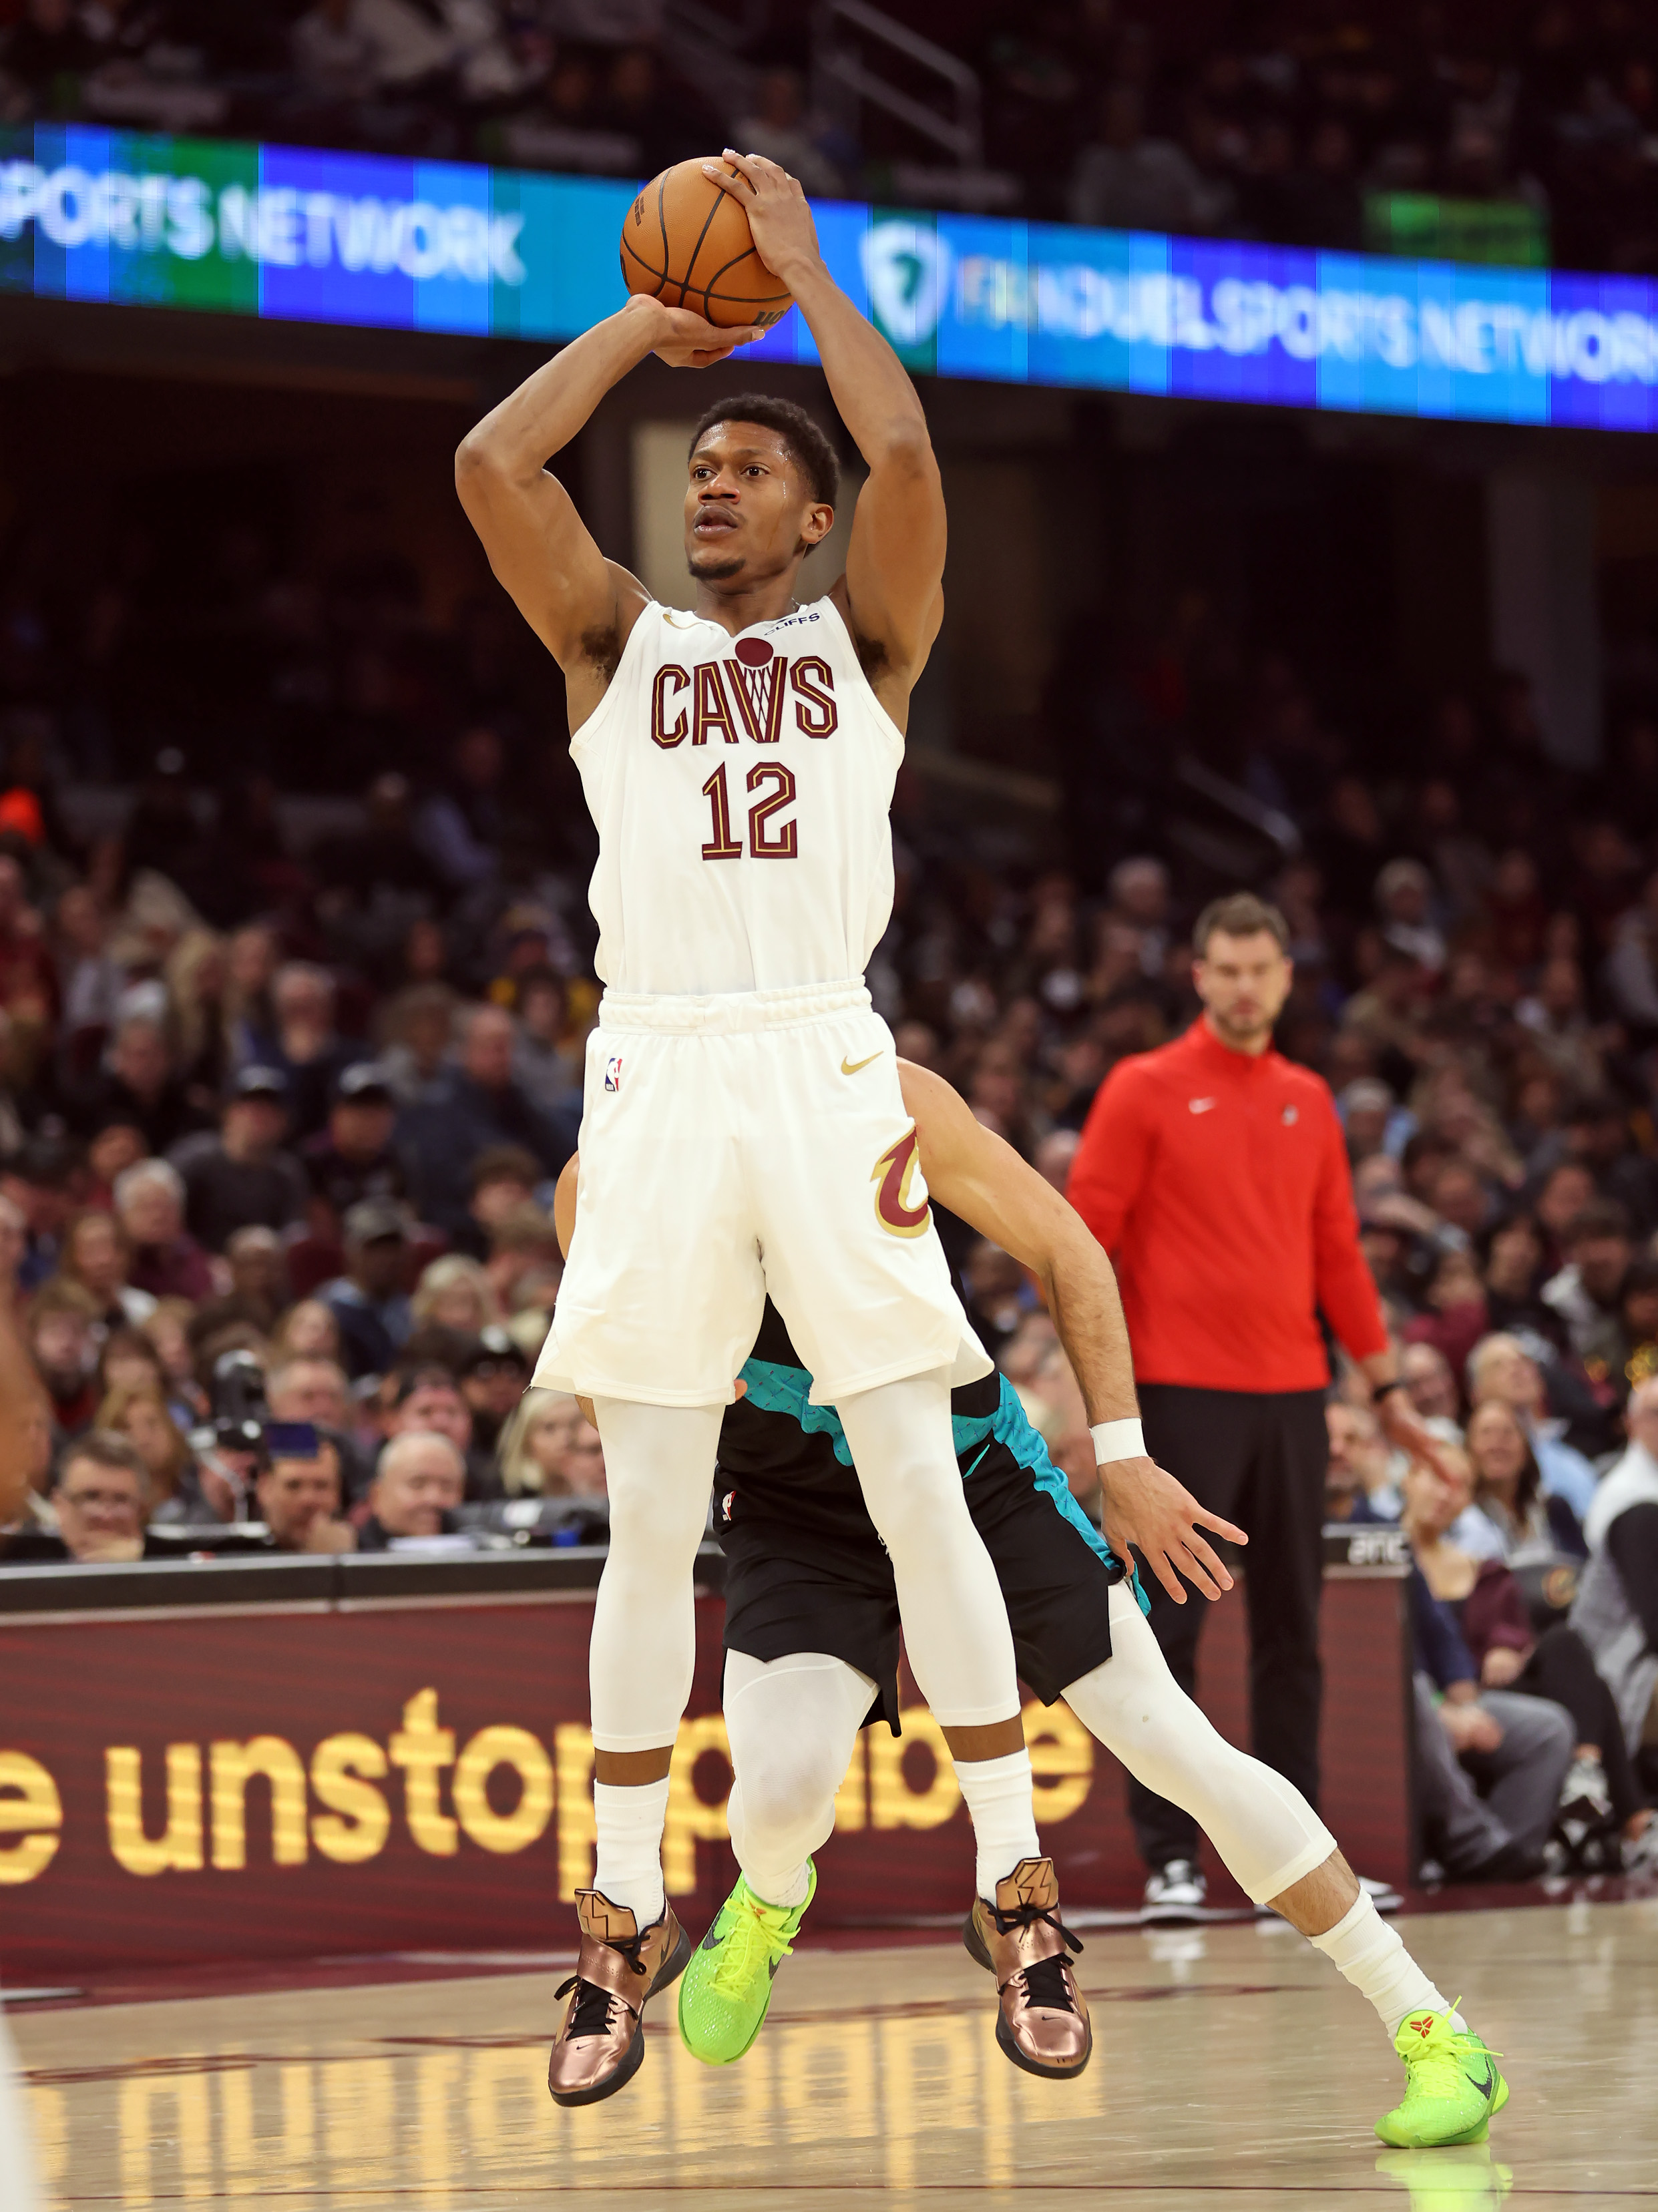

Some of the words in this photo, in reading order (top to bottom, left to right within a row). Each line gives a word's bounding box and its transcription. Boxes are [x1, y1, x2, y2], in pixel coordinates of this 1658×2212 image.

[219, 182, 526, 286] NETWORK
[1211, 277, 1414, 369] SPORTS
[764, 612, 820, 636] CLIFFS
[651, 656, 838, 749] CAVS
[702, 761, 797, 861] 12
[105, 1687, 1094, 1904] unstoppbe
